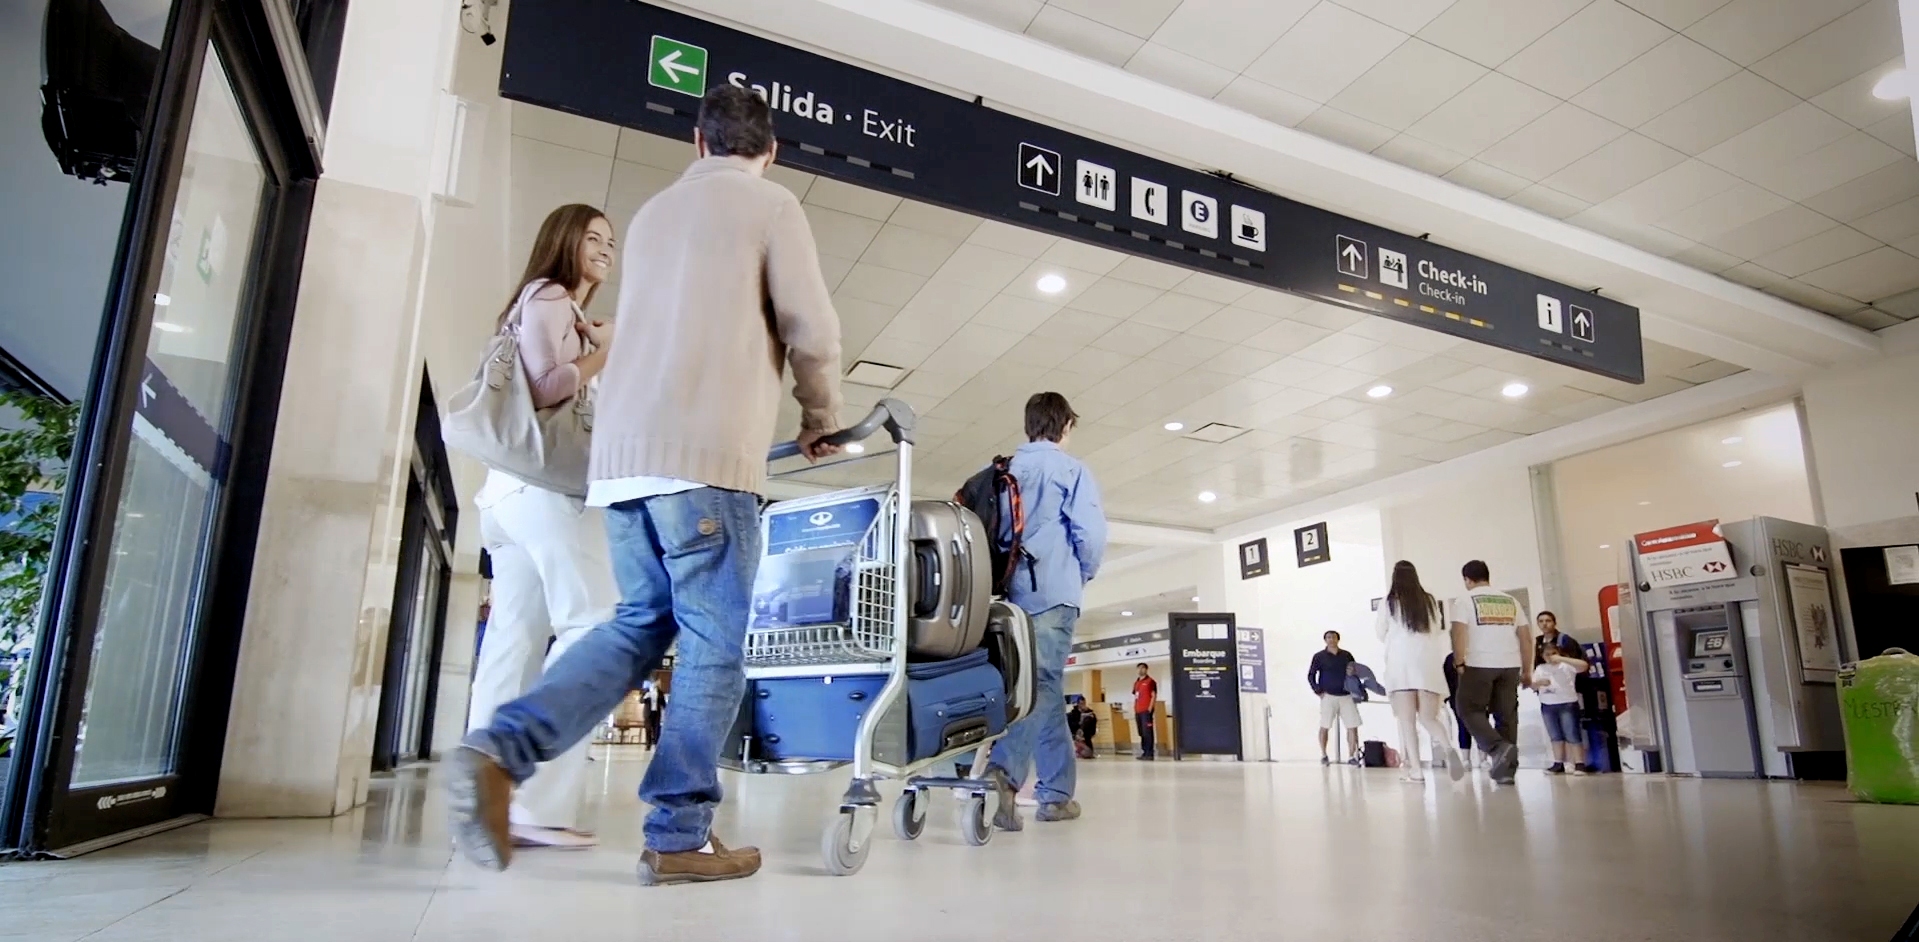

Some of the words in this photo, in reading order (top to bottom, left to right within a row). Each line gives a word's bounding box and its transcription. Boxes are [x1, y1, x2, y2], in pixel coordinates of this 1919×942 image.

[862, 108, 916, 149] Exit
[1417, 258, 1489, 296] Check-in
[1418, 281, 1467, 306] Check-in
[1307, 532, 1314, 545] 2
[1249, 548, 1255, 560] 1
[1771, 537, 1805, 560] HSBC
[1650, 566, 1695, 582] HSBC
[1182, 649, 1226, 659] Embarque
